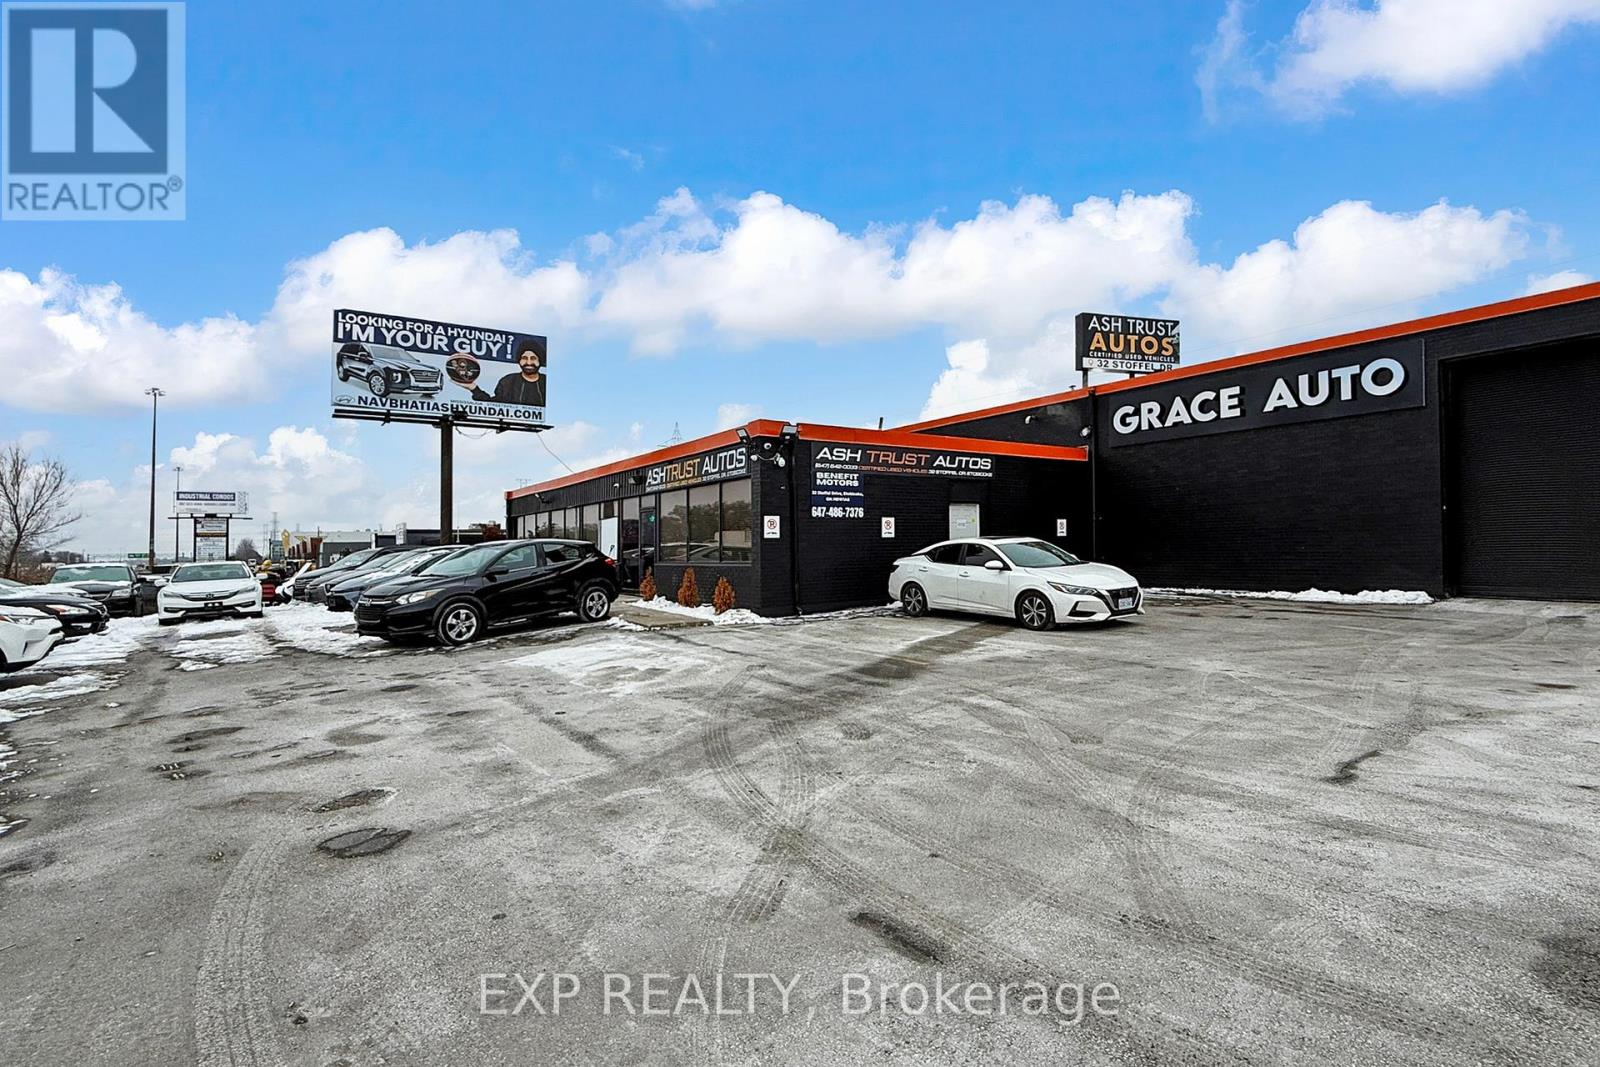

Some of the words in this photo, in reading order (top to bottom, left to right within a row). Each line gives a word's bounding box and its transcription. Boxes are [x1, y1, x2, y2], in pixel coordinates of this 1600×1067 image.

[338, 312, 403, 329] LOOKING
[406, 321, 434, 334] FOR
[436, 325, 445, 335] A
[1088, 315, 1122, 333] ASH
[1127, 319, 1174, 336] TRUST
[337, 322, 374, 342] I'M
[381, 328, 449, 352] YOUR
[1090, 332, 1174, 356] AUTOS
[1089, 351, 1123, 359] CERTIFIED
[1097, 359, 1109, 368] 32
[1112, 361, 1155, 371] STOFFEL
[1113, 385, 1241, 434] GRACE
[1262, 357, 1405, 413] AUTO
[358, 395, 543, 420] NAVBHATIASHYUNDAI.COM
[702, 447, 746, 475] AUTOS
[815, 447, 862, 462] ASH
[867, 450, 931, 466] TRUST
[932, 455, 992, 470] AUTOS
[816, 472, 859, 480] BENEFIT
[816, 479, 859, 487] MOTORS
[811, 506, 864, 518] 647-486-7376
